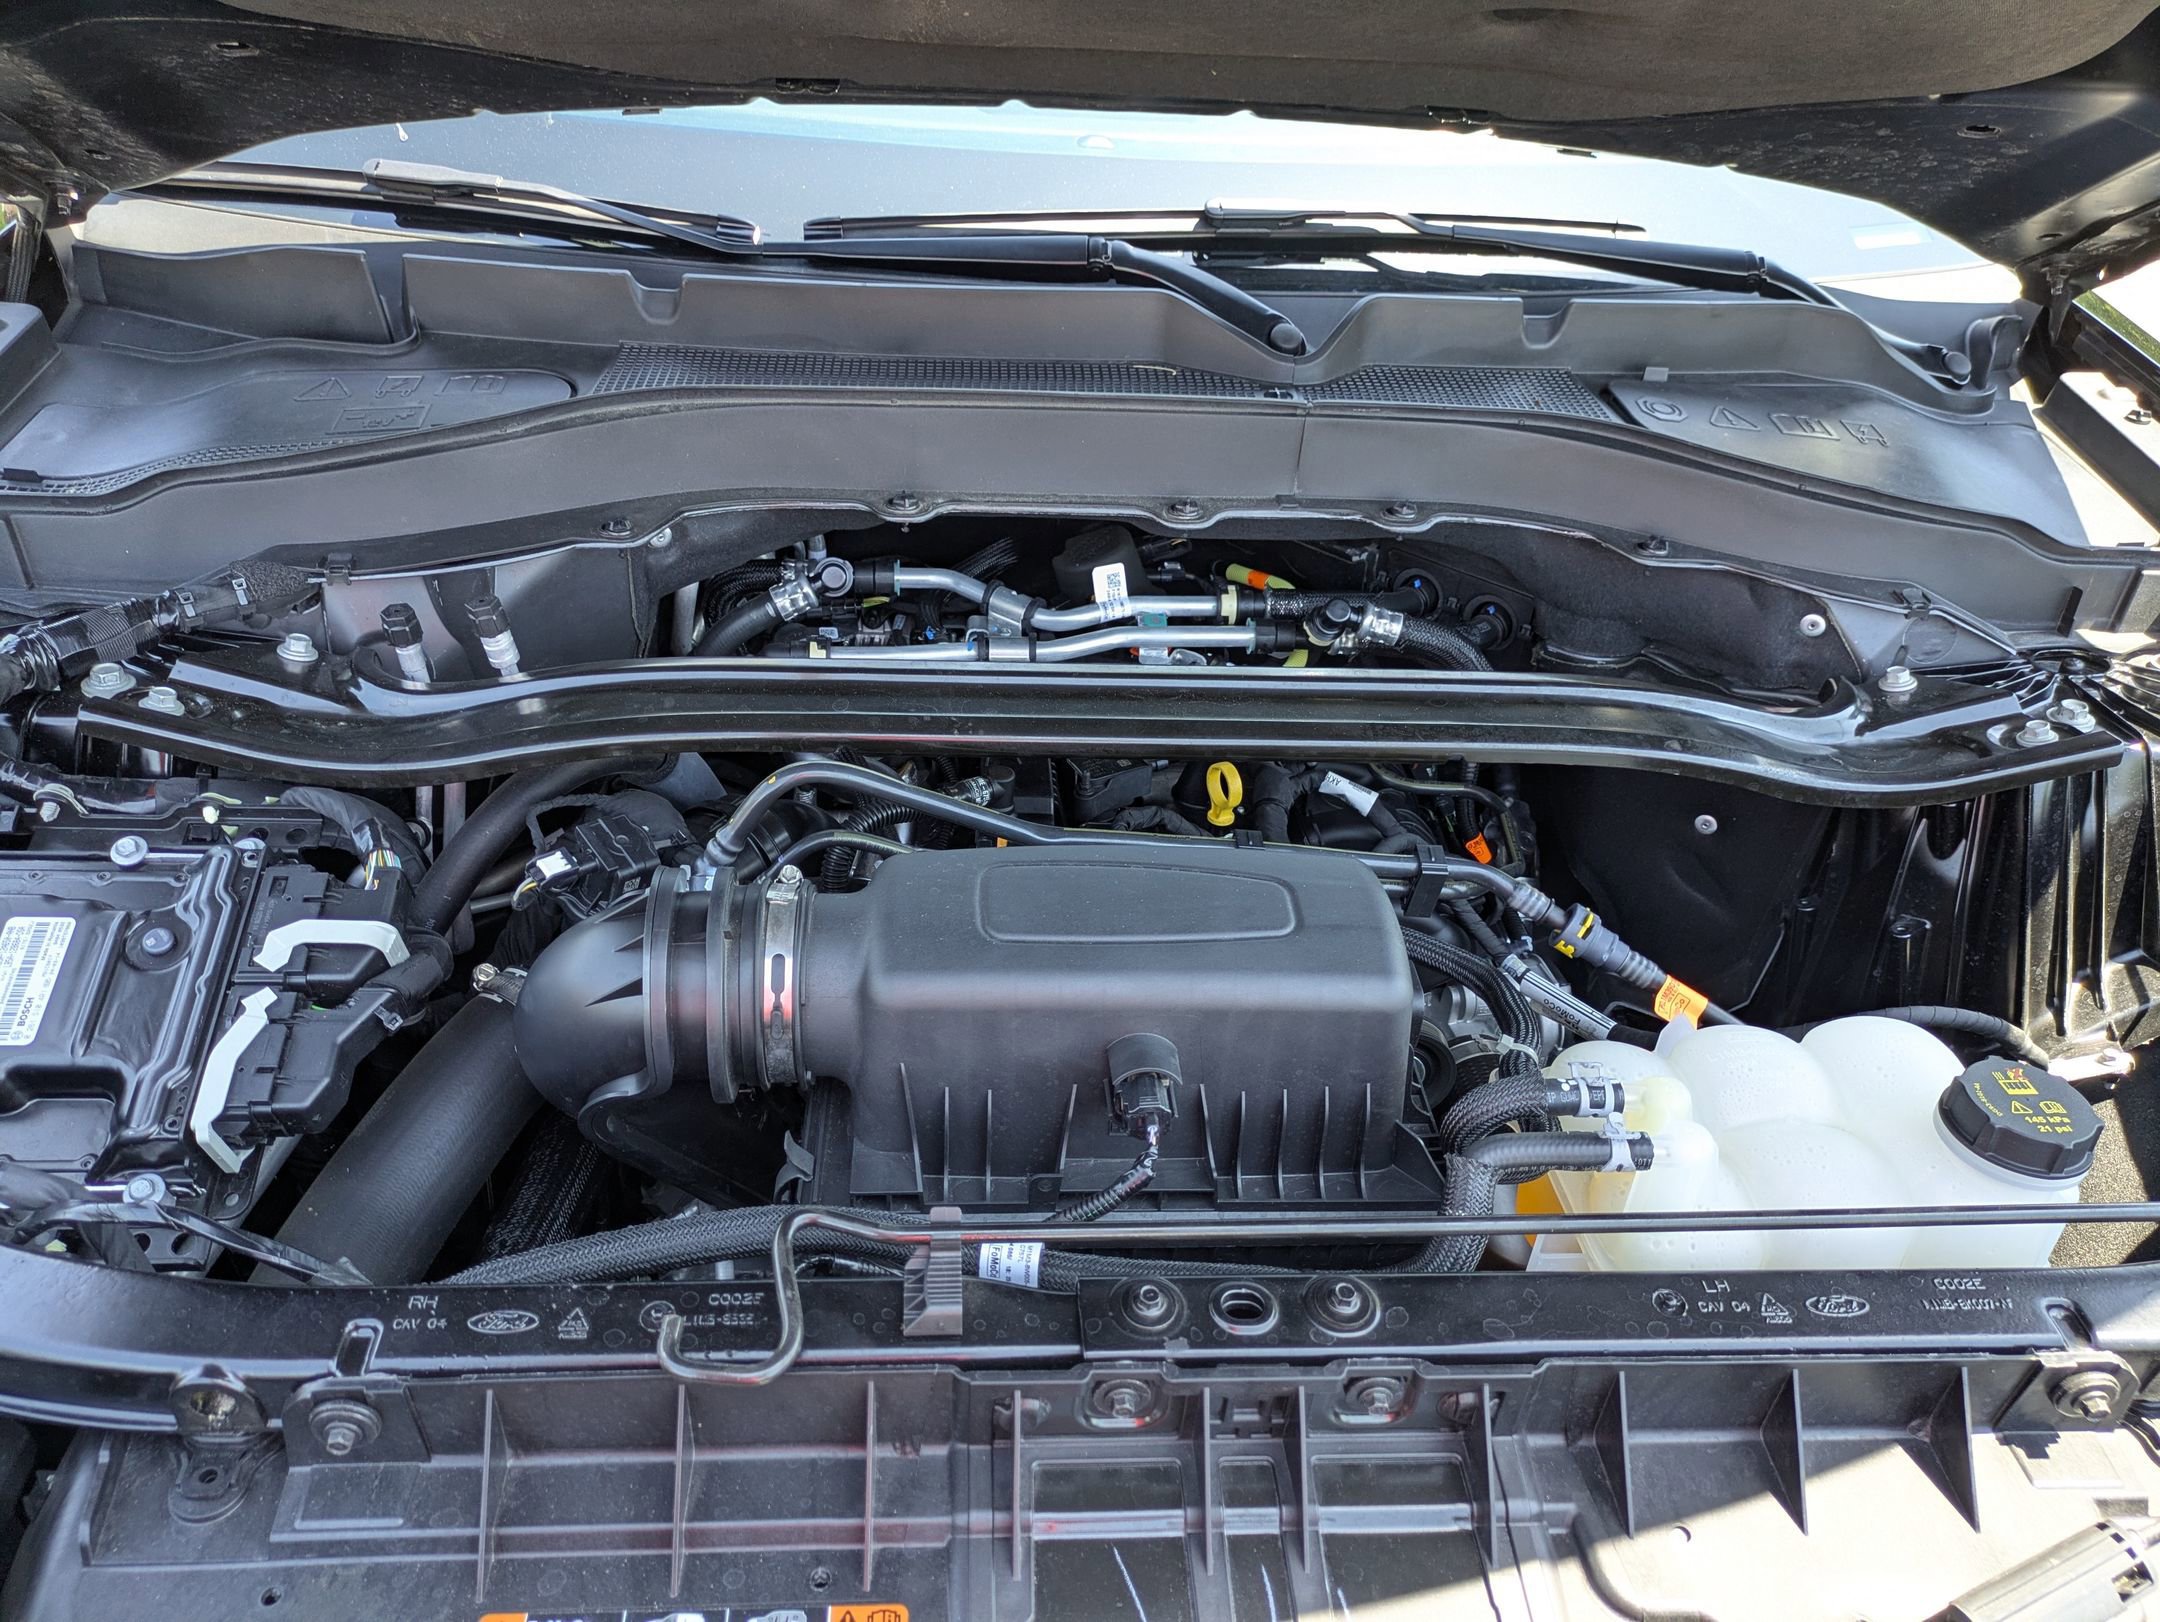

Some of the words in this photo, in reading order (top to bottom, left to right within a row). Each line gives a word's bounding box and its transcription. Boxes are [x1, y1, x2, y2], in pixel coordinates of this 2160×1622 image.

[17, 997, 34, 1027] BOSCH
[1543, 998, 1581, 1026] FoMoCo
[2025, 1116, 2047, 1124] 145
[2047, 1116, 2071, 1124] kPa
[2037, 1125, 2052, 1133] 21
[2057, 1125, 2073, 1134] psi
[989, 1246, 1001, 1278] FoMoCo
[1702, 1280, 1731, 1293] LH
[408, 1295, 439, 1309] RH
[1698, 1300, 1724, 1312] CAV
[1812, 1296, 1864, 1314] Ford
[393, 1317, 419, 1330] CAV
[474, 1312, 533, 1331] Ford
